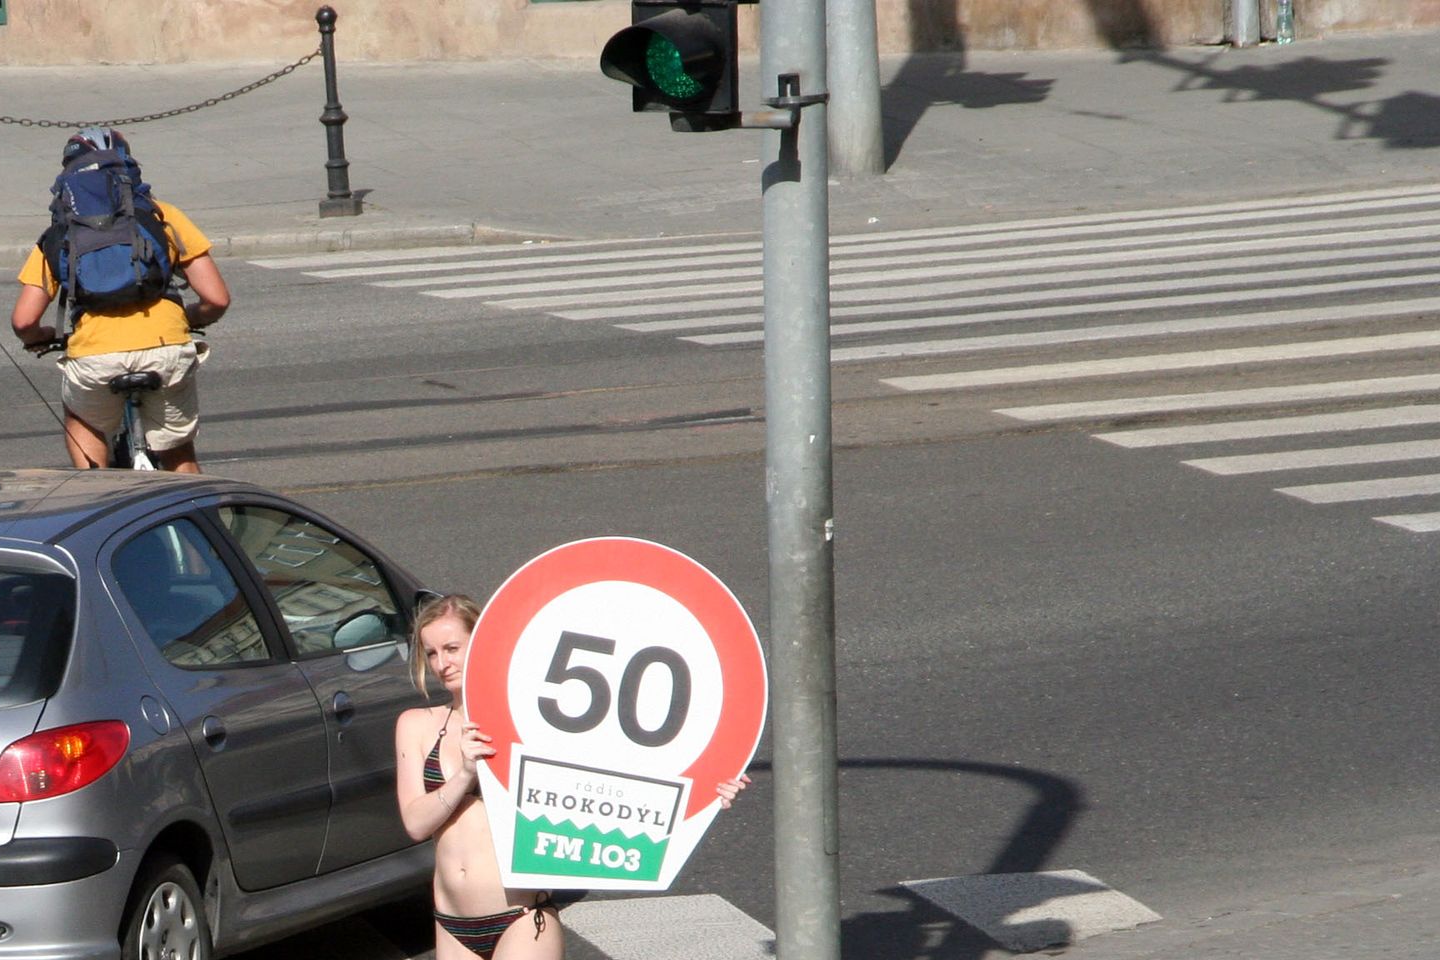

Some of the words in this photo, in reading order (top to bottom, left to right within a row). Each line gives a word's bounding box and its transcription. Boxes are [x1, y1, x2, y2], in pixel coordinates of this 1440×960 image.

[537, 630, 691, 747] 50
[526, 788, 665, 826] KROKODÝL
[534, 831, 584, 861] FM
[589, 842, 641, 872] 103
